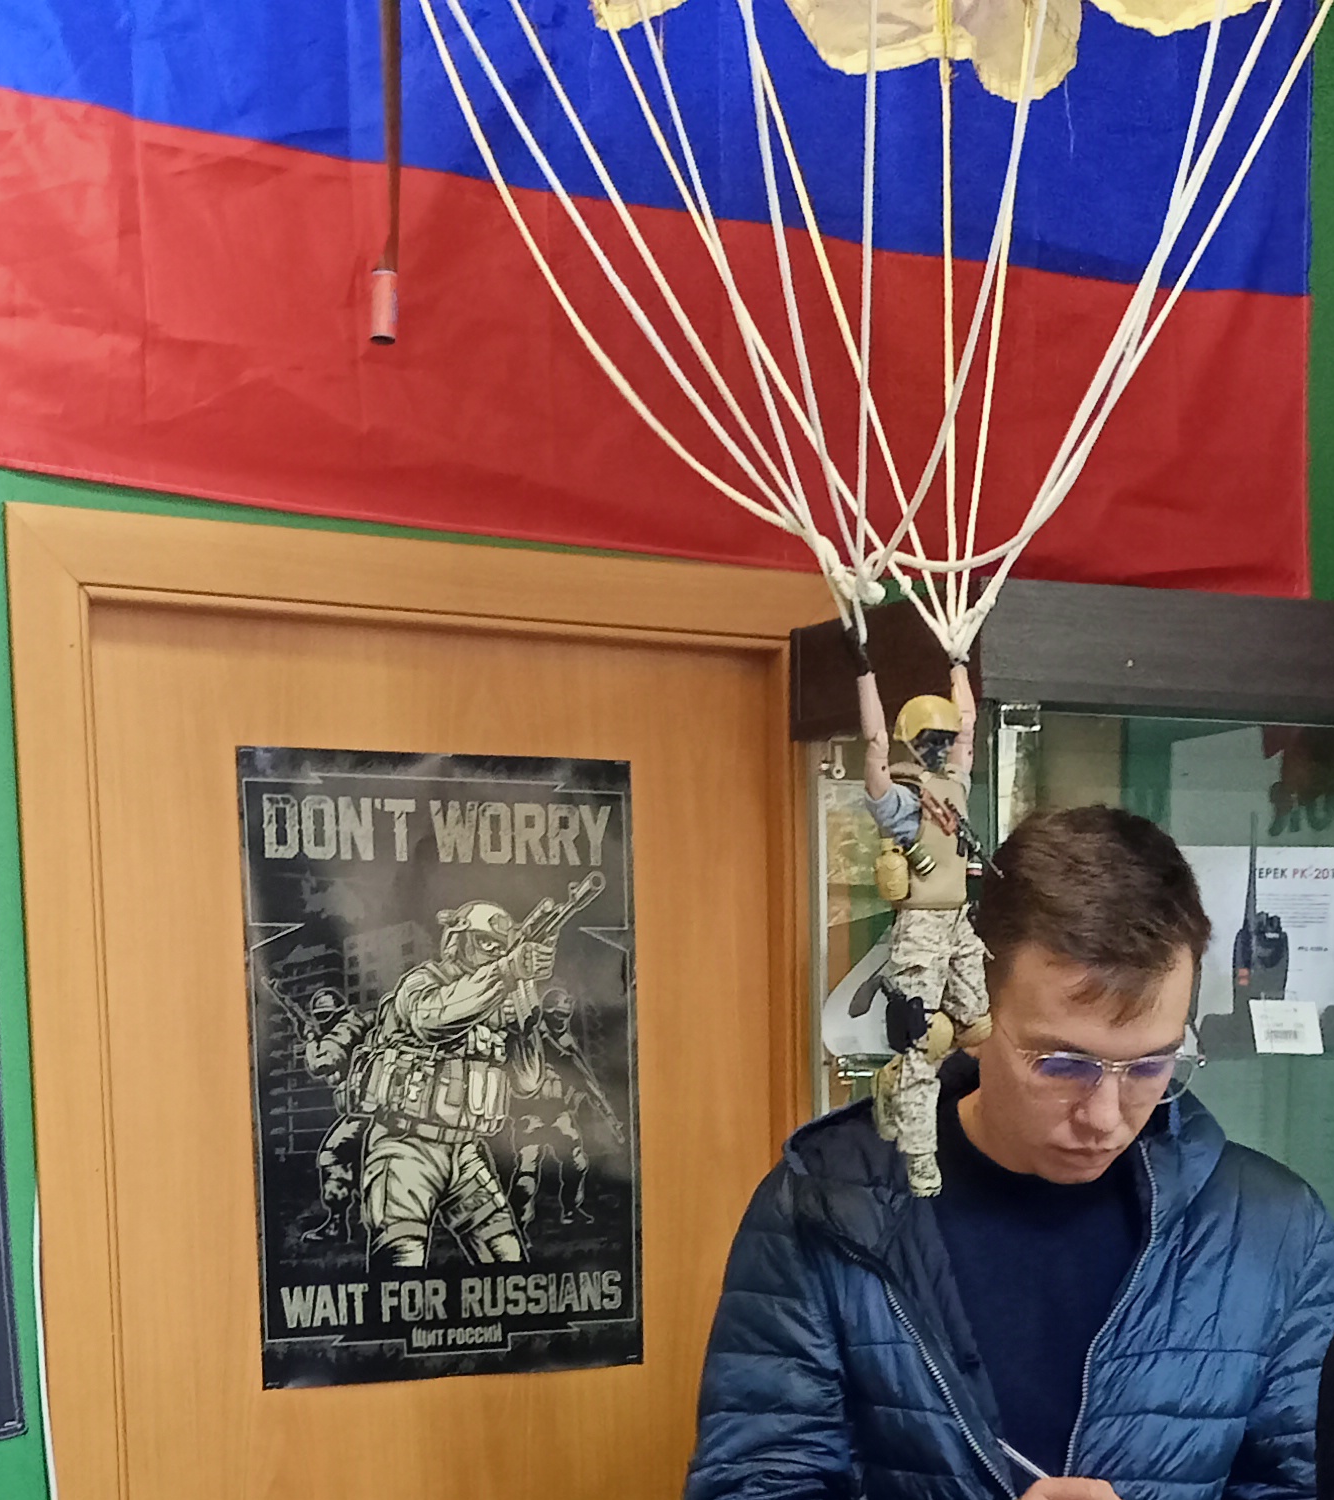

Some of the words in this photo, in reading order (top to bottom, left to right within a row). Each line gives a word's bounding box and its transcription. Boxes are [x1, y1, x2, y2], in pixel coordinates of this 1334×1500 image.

[262, 793, 417, 862] DON'T
[429, 799, 612, 866] WORRY
[1255, 867, 1288, 880] ЕРЕК
[280, 1283, 369, 1329] WAIT
[380, 1279, 447, 1323] FOR
[461, 1270, 622, 1318] RUSSIANS
[412, 1325, 445, 1349] ЩИТ
[447, 1321, 502, 1345] РОССИИ
